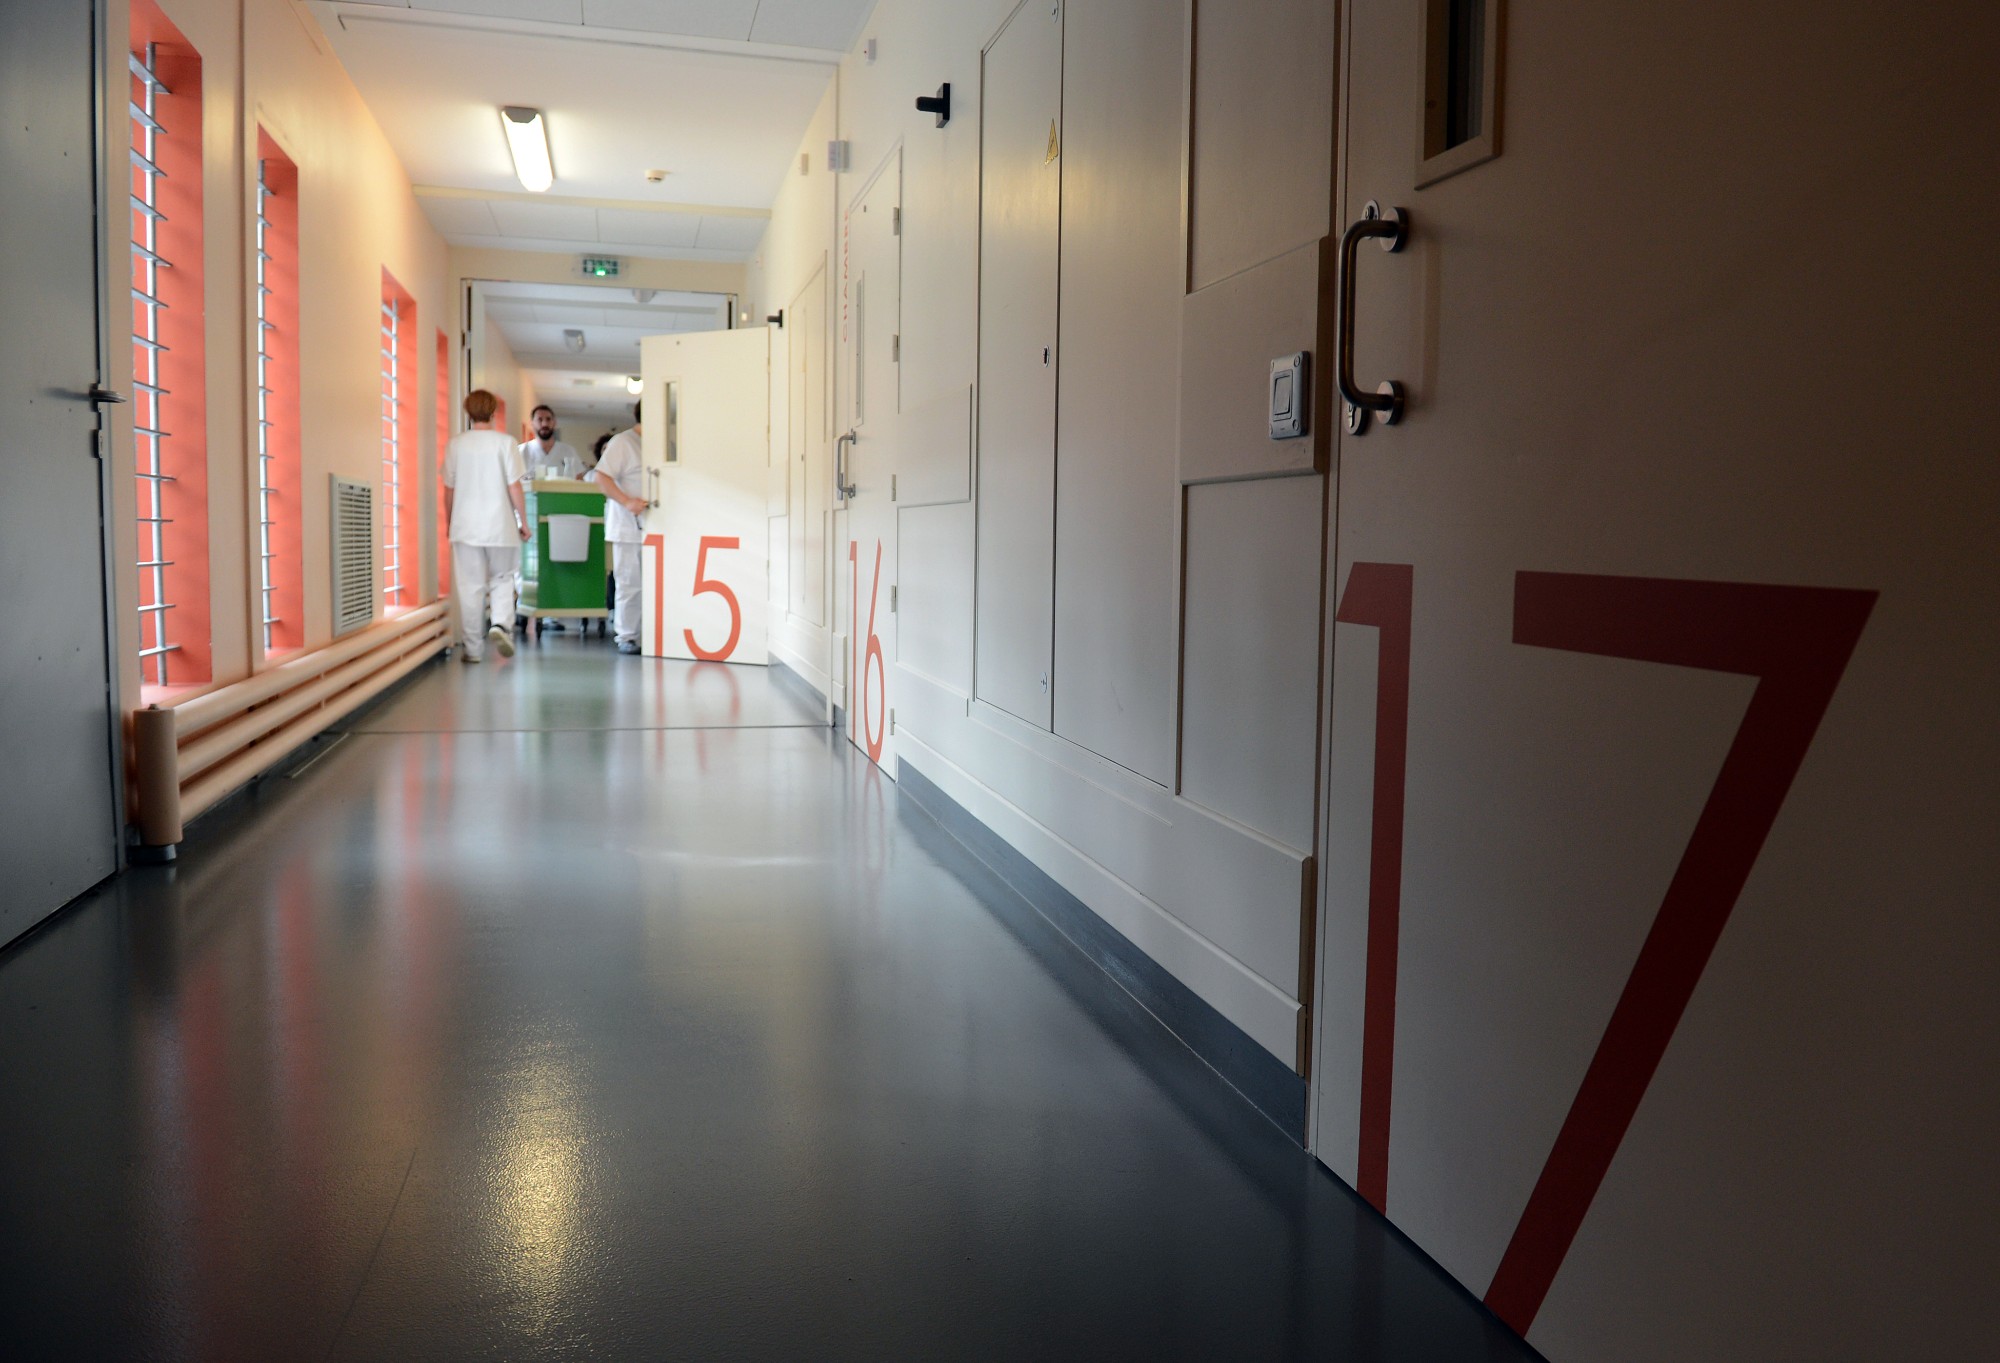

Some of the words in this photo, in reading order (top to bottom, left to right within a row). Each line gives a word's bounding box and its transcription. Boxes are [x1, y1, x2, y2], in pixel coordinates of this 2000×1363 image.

[643, 534, 741, 662] 15
[849, 537, 885, 763] 16
[1336, 562, 1879, 1339] 17
